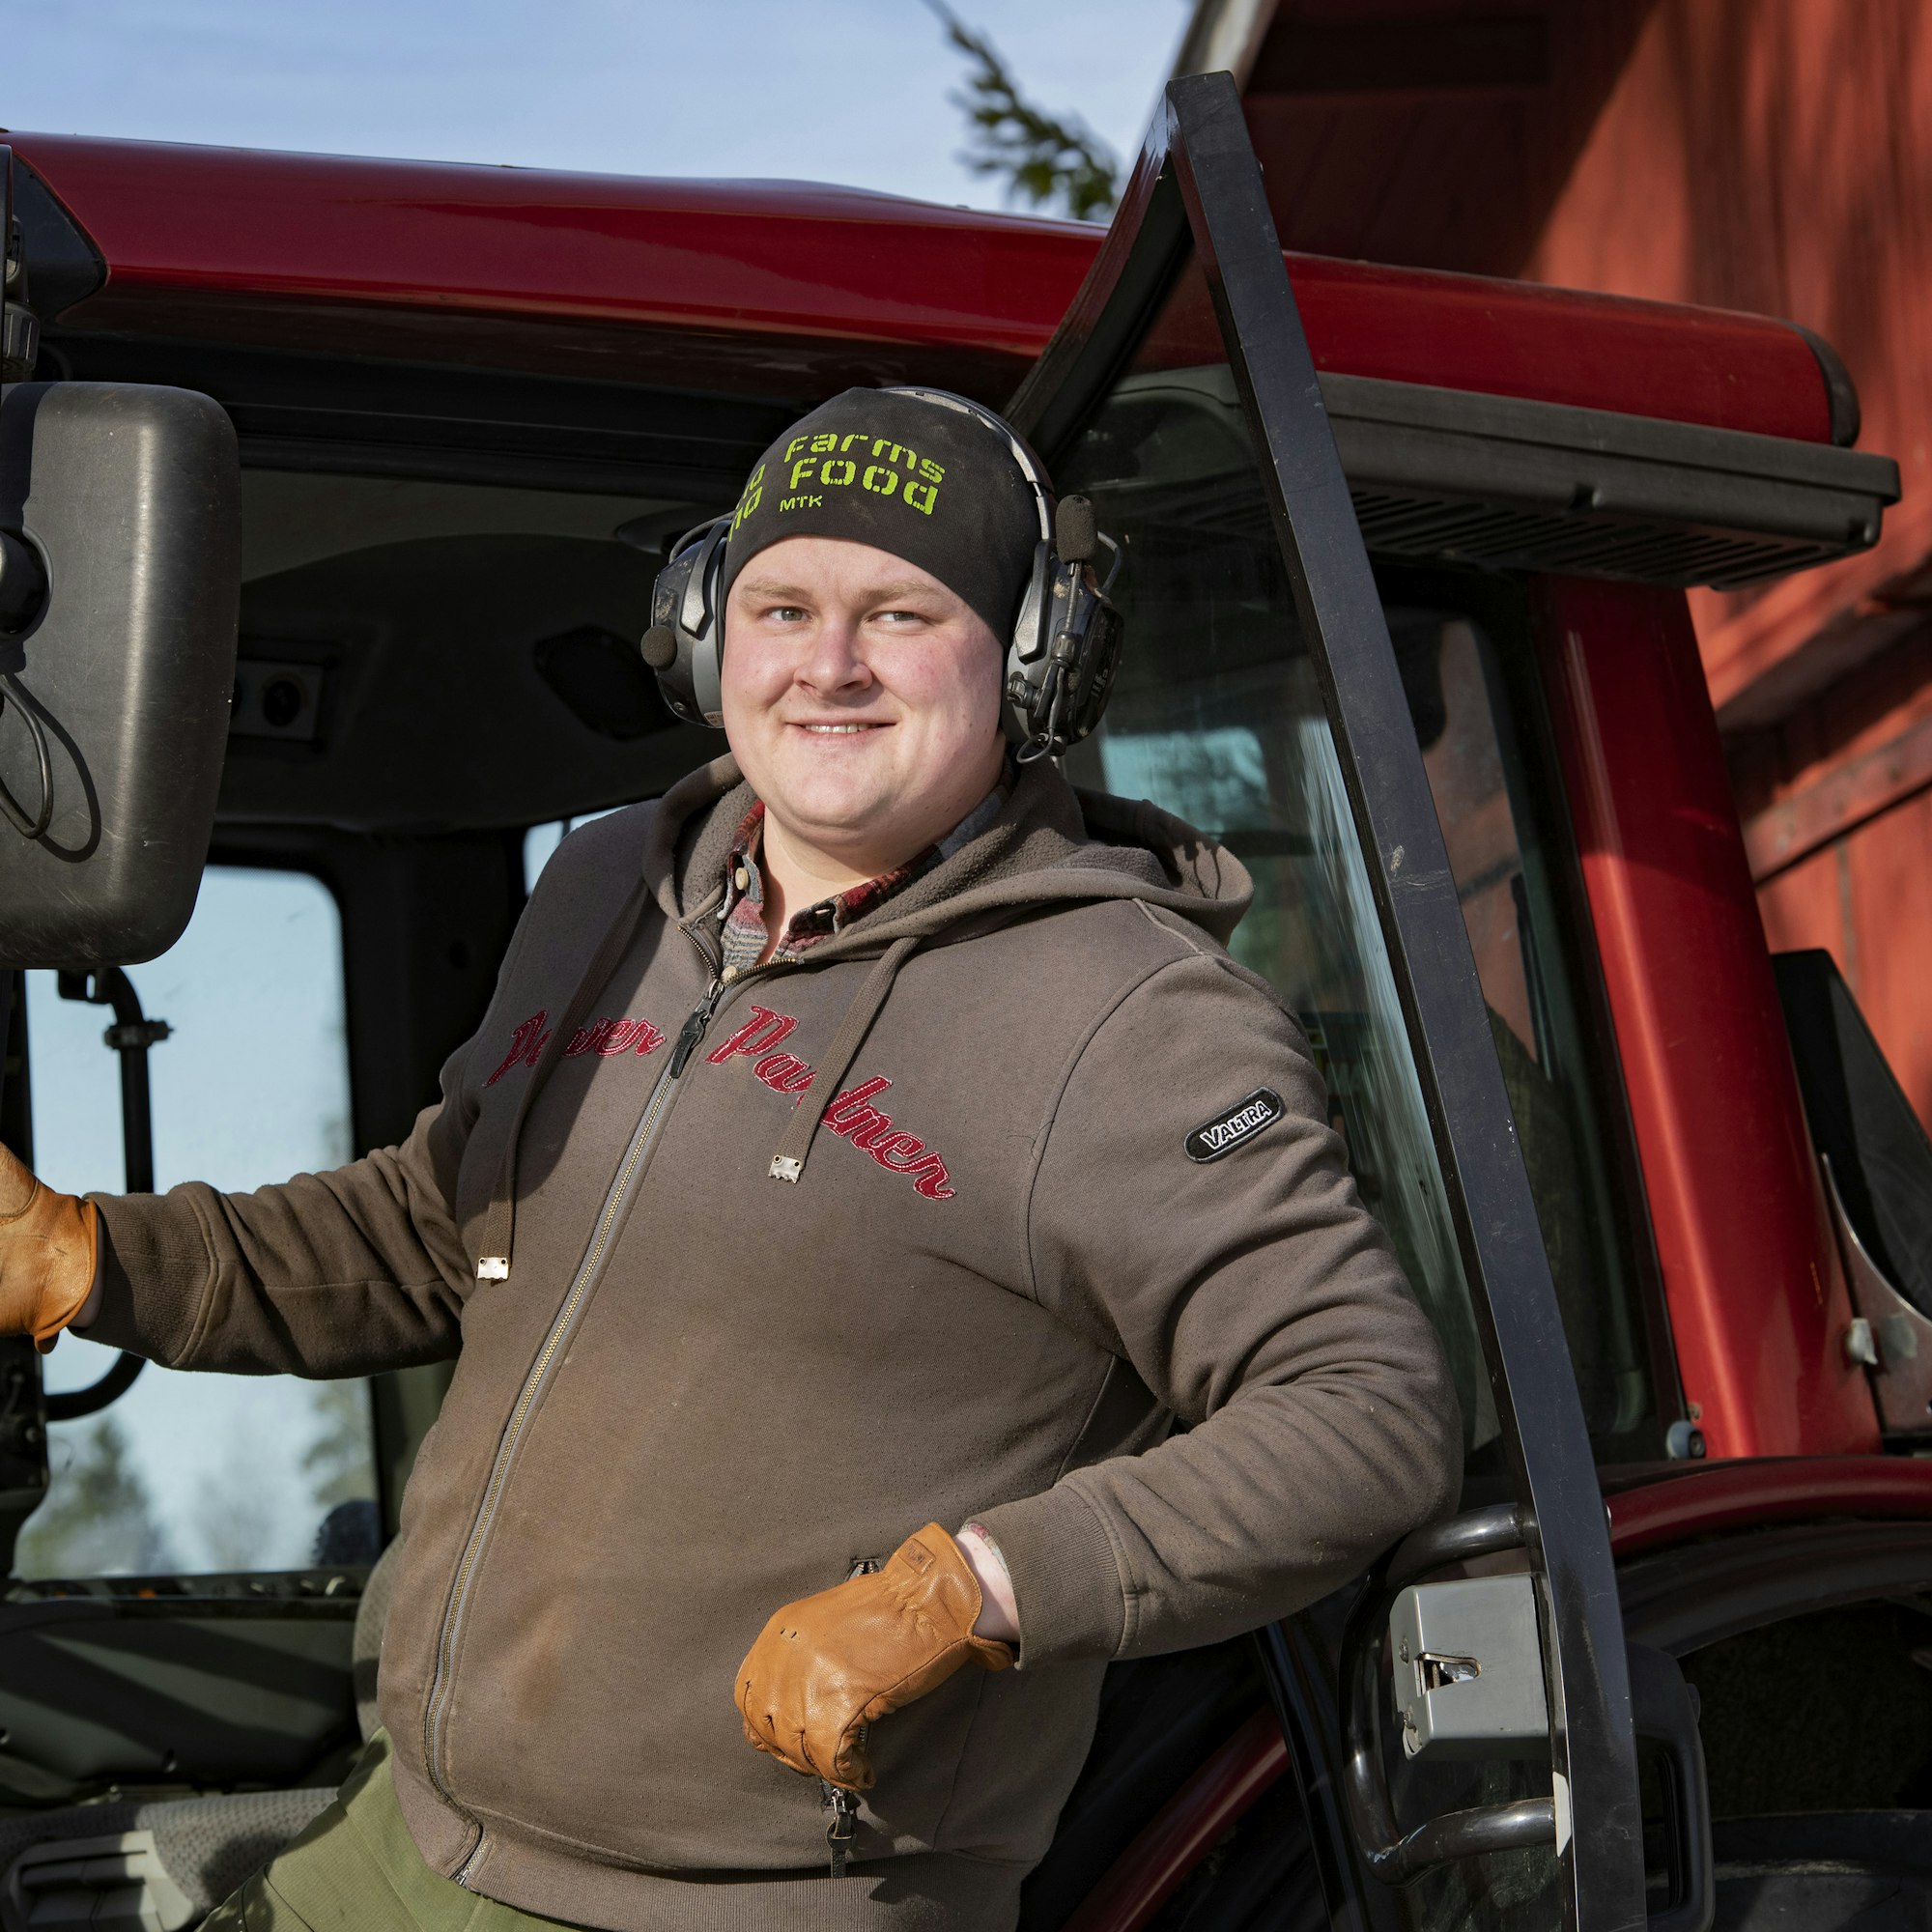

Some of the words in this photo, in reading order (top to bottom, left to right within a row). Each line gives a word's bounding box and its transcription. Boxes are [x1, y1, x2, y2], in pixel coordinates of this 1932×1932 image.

[783, 433, 946, 484] Farms
[780, 495, 823, 512] MTK
[705, 1005, 956, 1201] Patner
[1199, 1100, 1272, 1150] VALTRA
